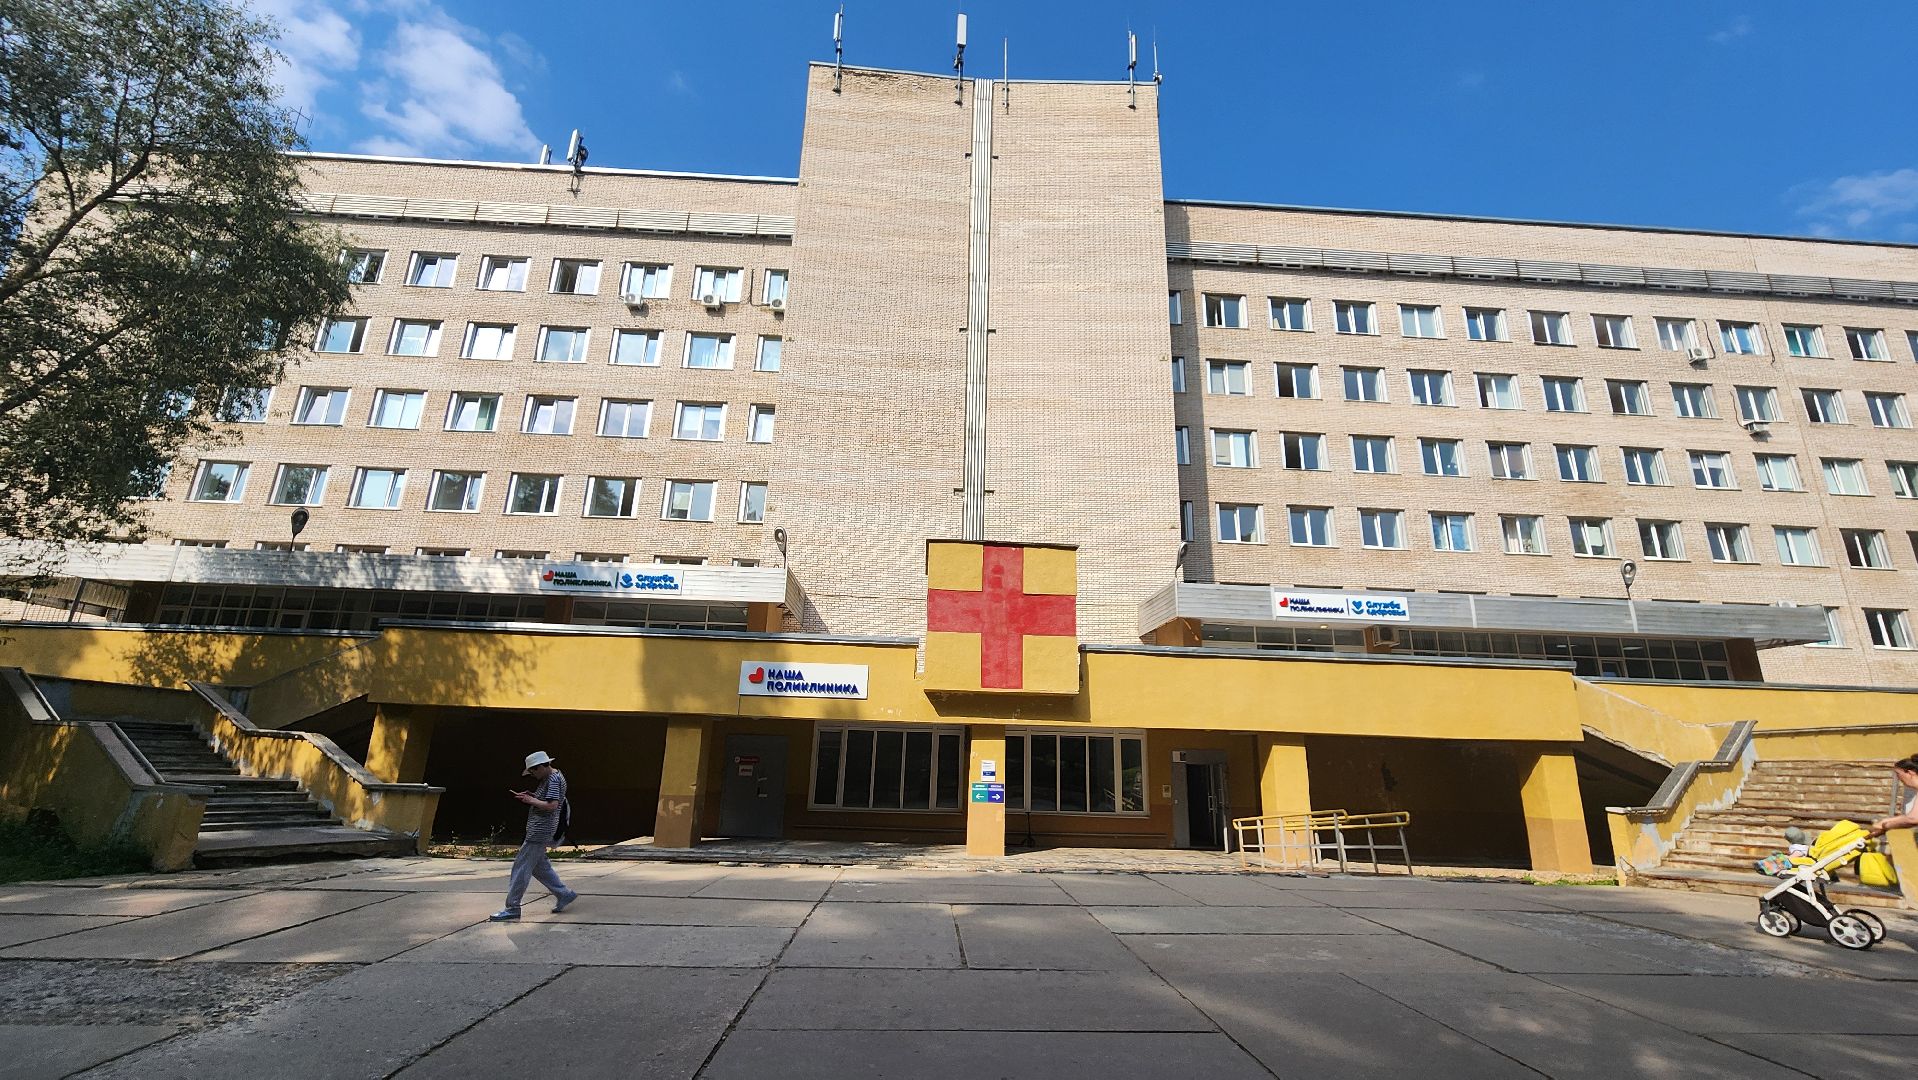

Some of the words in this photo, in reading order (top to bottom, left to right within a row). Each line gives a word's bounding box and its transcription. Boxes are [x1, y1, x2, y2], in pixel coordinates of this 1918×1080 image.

[555, 570, 577, 579] НАША
[553, 579, 611, 587] ПОЛИКЛИНИКА
[768, 669, 805, 681] НАША
[767, 681, 860, 695] ПОЛИКЛИНИКА
